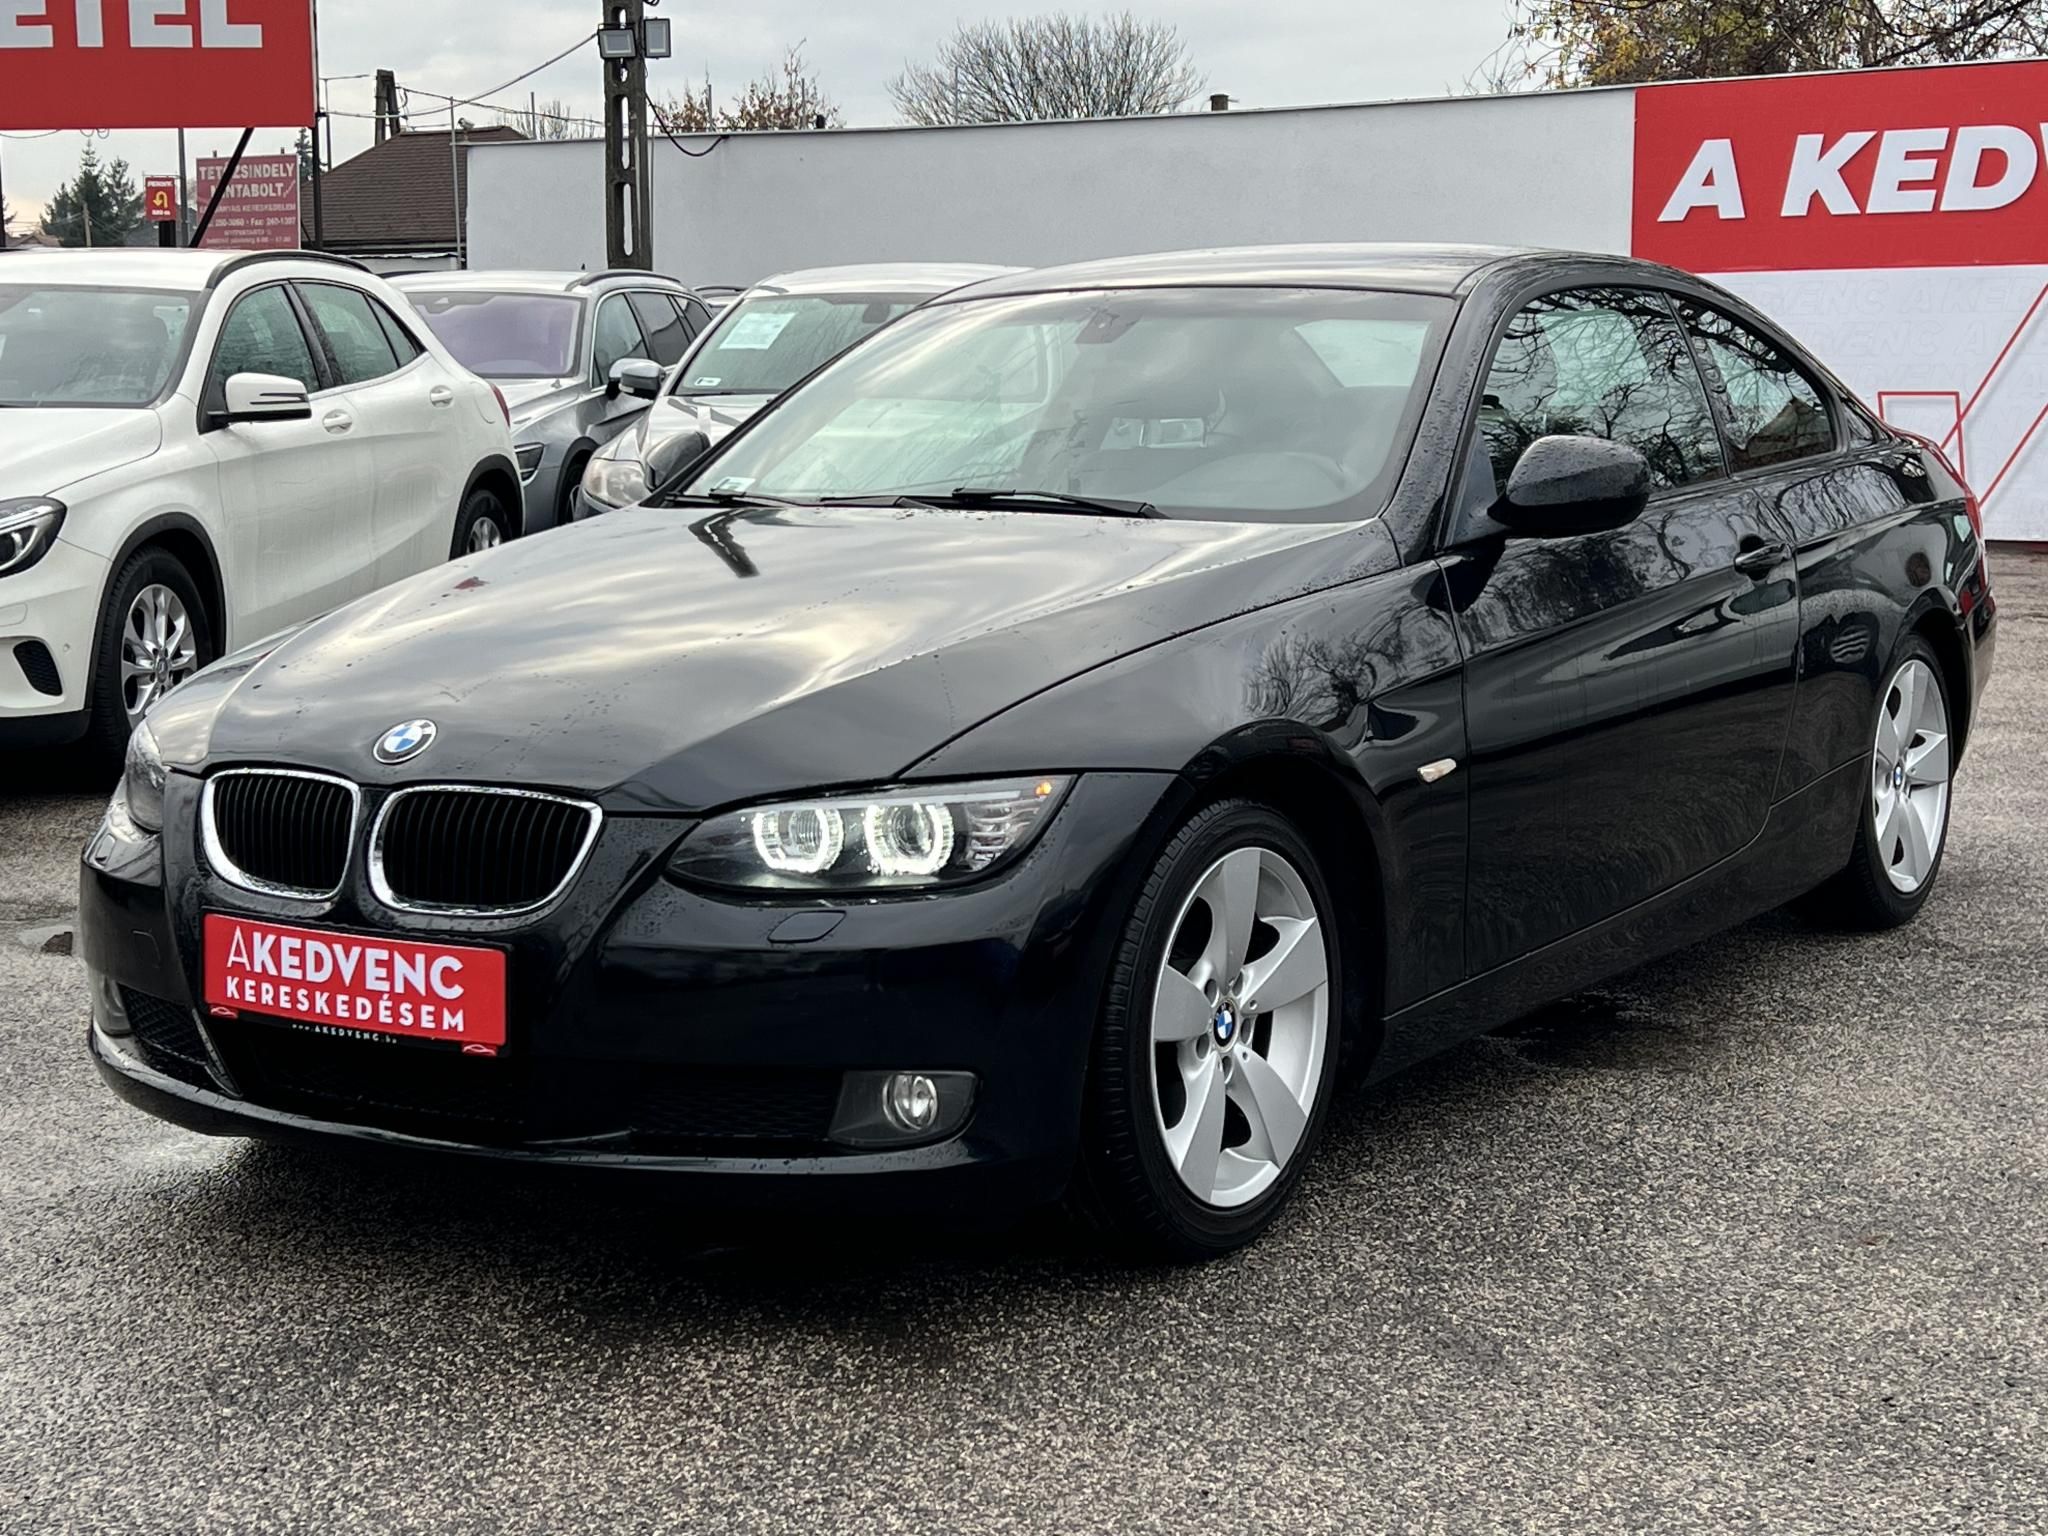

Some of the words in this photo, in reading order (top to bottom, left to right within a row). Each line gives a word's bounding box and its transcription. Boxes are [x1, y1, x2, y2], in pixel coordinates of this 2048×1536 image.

[199, 162, 295, 181] TETZSINDELY
[1657, 138, 1745, 222] A
[1780, 122, 2048, 217] KED
[226, 925, 465, 1001] AKEDVENC
[226, 975, 465, 1033] KERESKEDÉSEM
